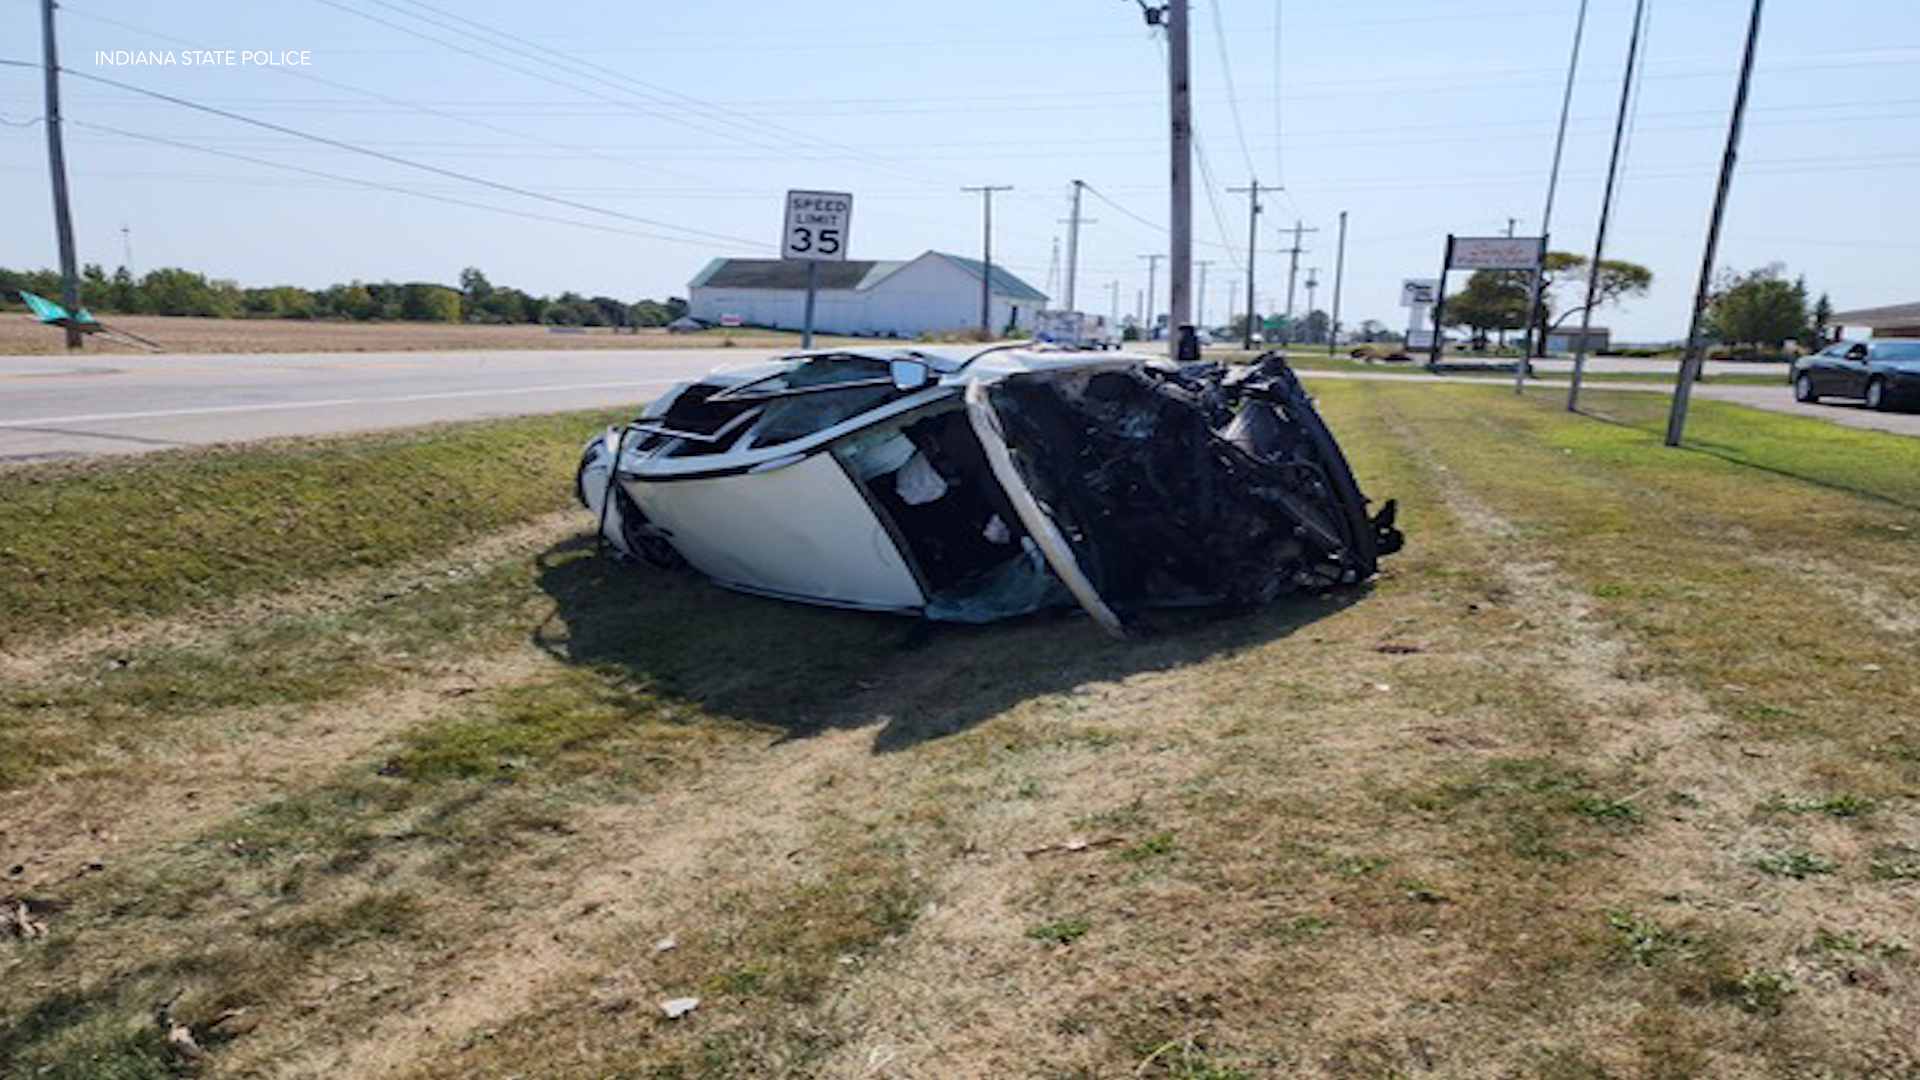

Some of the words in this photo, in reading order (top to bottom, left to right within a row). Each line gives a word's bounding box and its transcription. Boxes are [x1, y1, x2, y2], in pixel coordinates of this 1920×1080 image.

[794, 198, 847, 212] SPEED
[796, 213, 838, 226] LIMIT
[791, 227, 839, 254] 35
